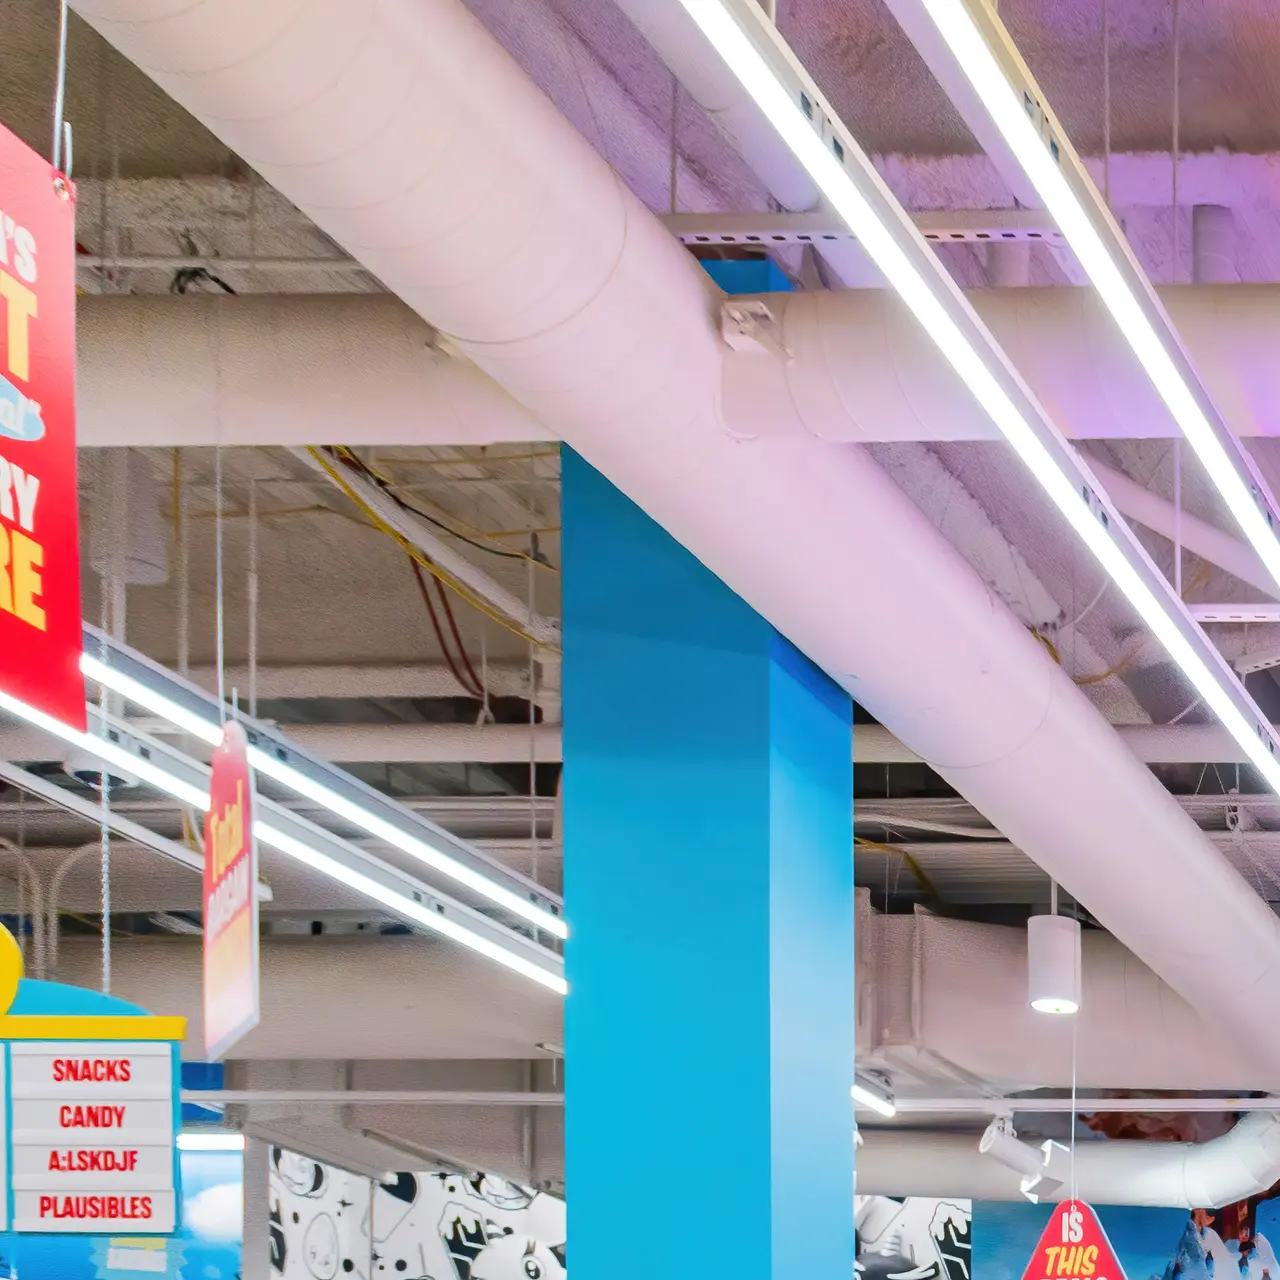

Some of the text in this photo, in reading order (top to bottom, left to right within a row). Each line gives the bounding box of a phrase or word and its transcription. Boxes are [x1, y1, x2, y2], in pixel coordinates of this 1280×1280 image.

[53, 1060, 131, 1082] SNACKS
[60, 1106, 126, 1128] CANDY
[40, 1197, 152, 1220] PLAUSIBLES
[1062, 1212, 1083, 1244] IS
[1045, 1246, 1097, 1275] THIS
